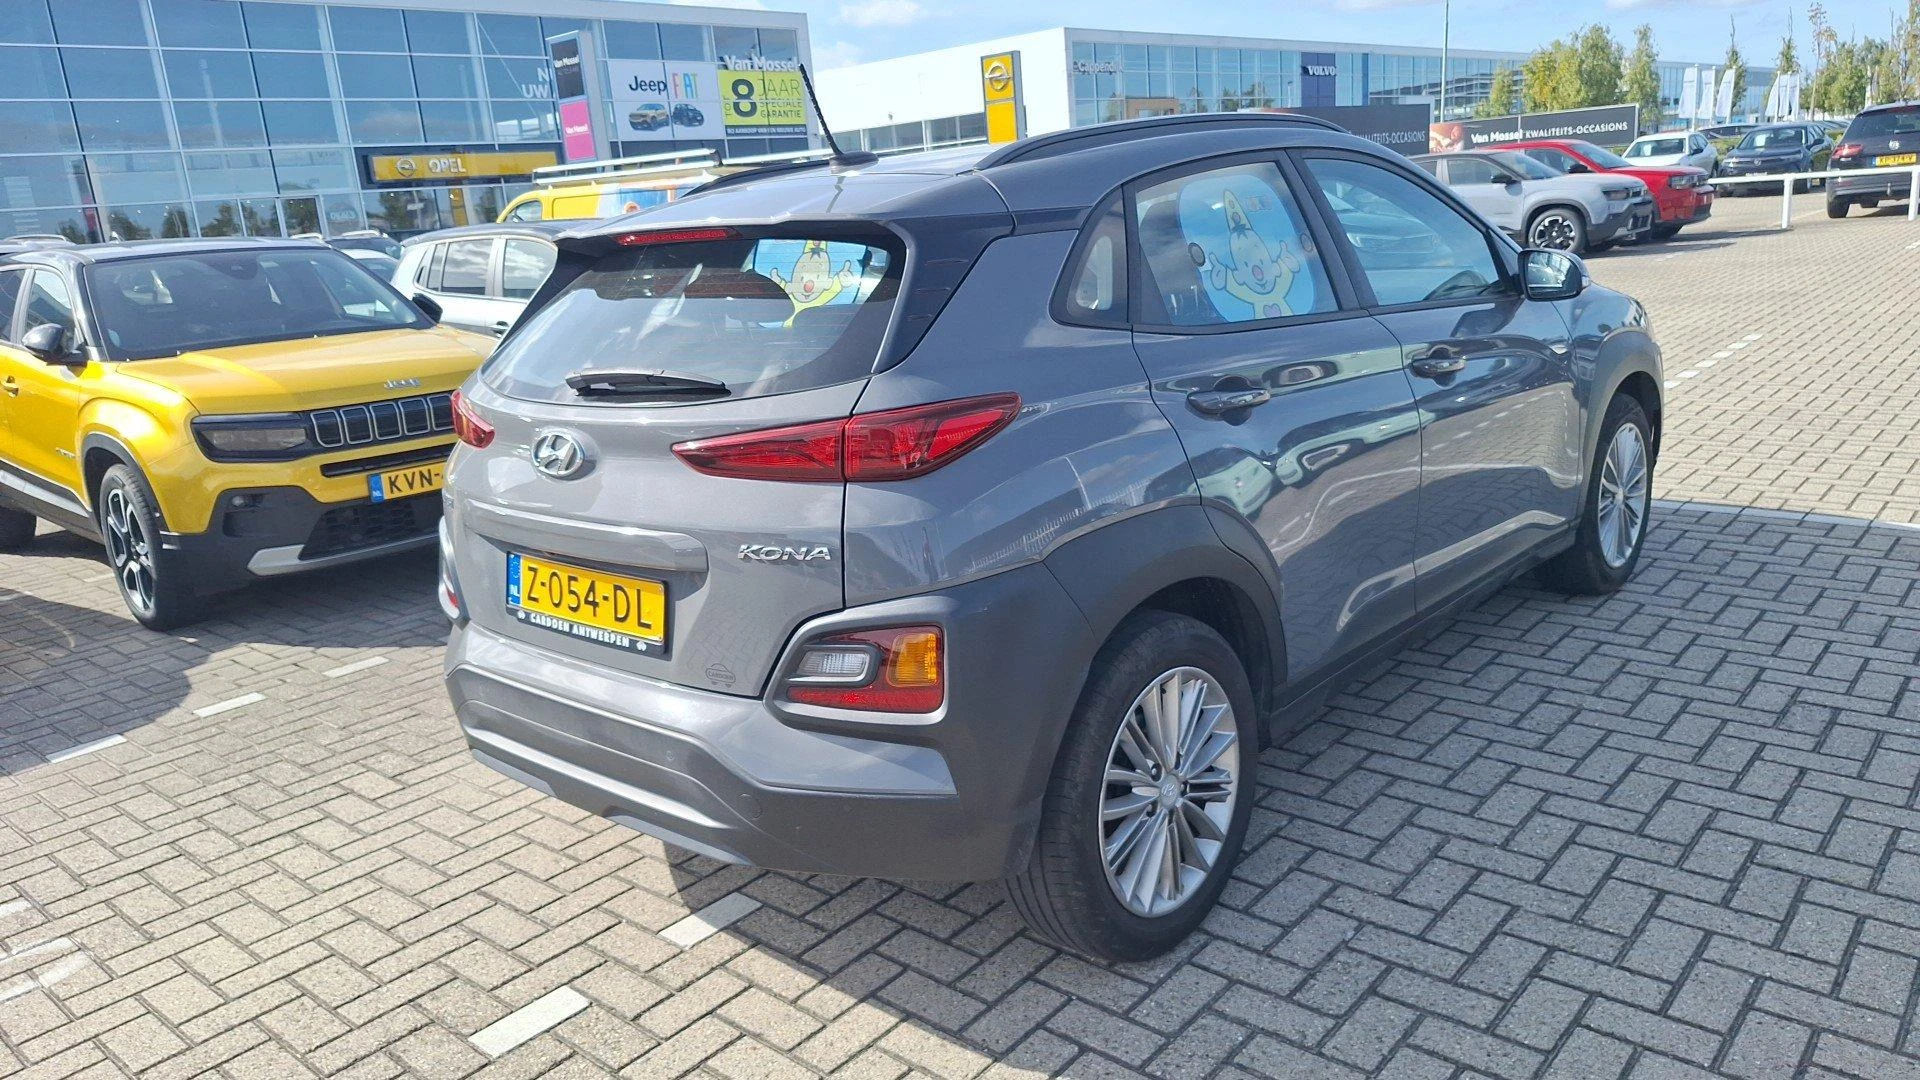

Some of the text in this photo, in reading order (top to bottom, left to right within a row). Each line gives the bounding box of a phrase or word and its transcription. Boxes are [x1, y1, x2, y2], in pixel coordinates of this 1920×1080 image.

[723, 54, 800, 71] Van Mossel
[1307, 65, 1337, 76] VOLVO
[628, 72, 699, 99] Jeep FIAT
[758, 79, 801, 96] JAAR
[723, 97, 732, 117] TOT
[732, 79, 757, 117] 8
[759, 98, 803, 108] SPECIALE
[760, 109, 802, 118] GARANTIE
[1470, 121, 1628, 144] Van Mossel KWALITEITS-OCCASIONS
[428, 158, 467, 173] OPEL
[388, 468, 444, 495] KVN-
[737, 543, 831, 561] KONA
[526, 565, 653, 630] Z-054-DL
[529, 612, 631, 648] CARDOEN ANTWERPEN
